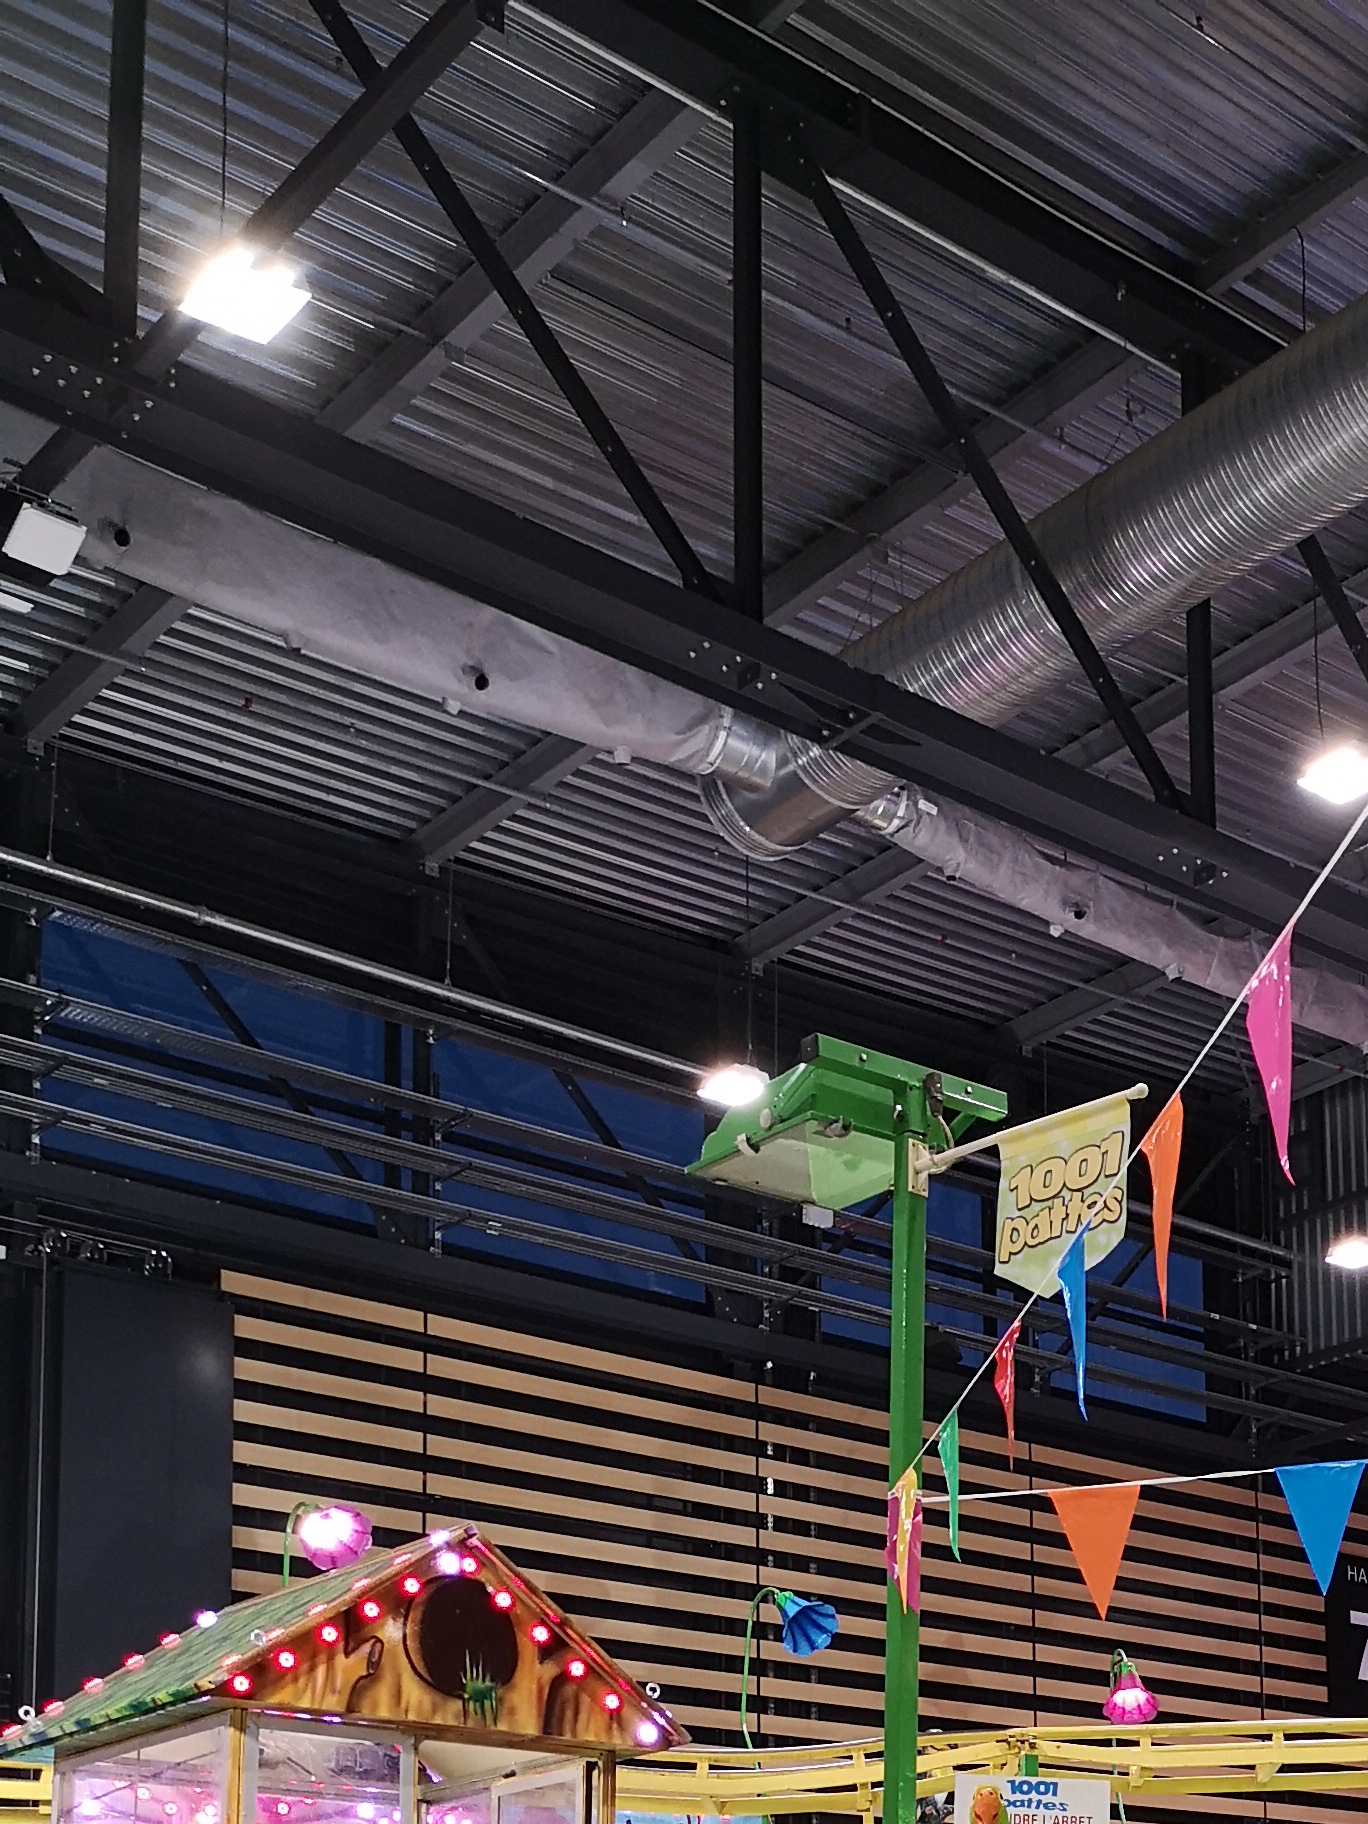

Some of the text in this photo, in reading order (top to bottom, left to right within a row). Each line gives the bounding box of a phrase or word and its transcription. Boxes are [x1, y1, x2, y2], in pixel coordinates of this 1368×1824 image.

[1009, 1131, 1124, 1211] 1001
[998, 1186, 1124, 1263] pattes
[1007, 1779, 1059, 1797] 1001
